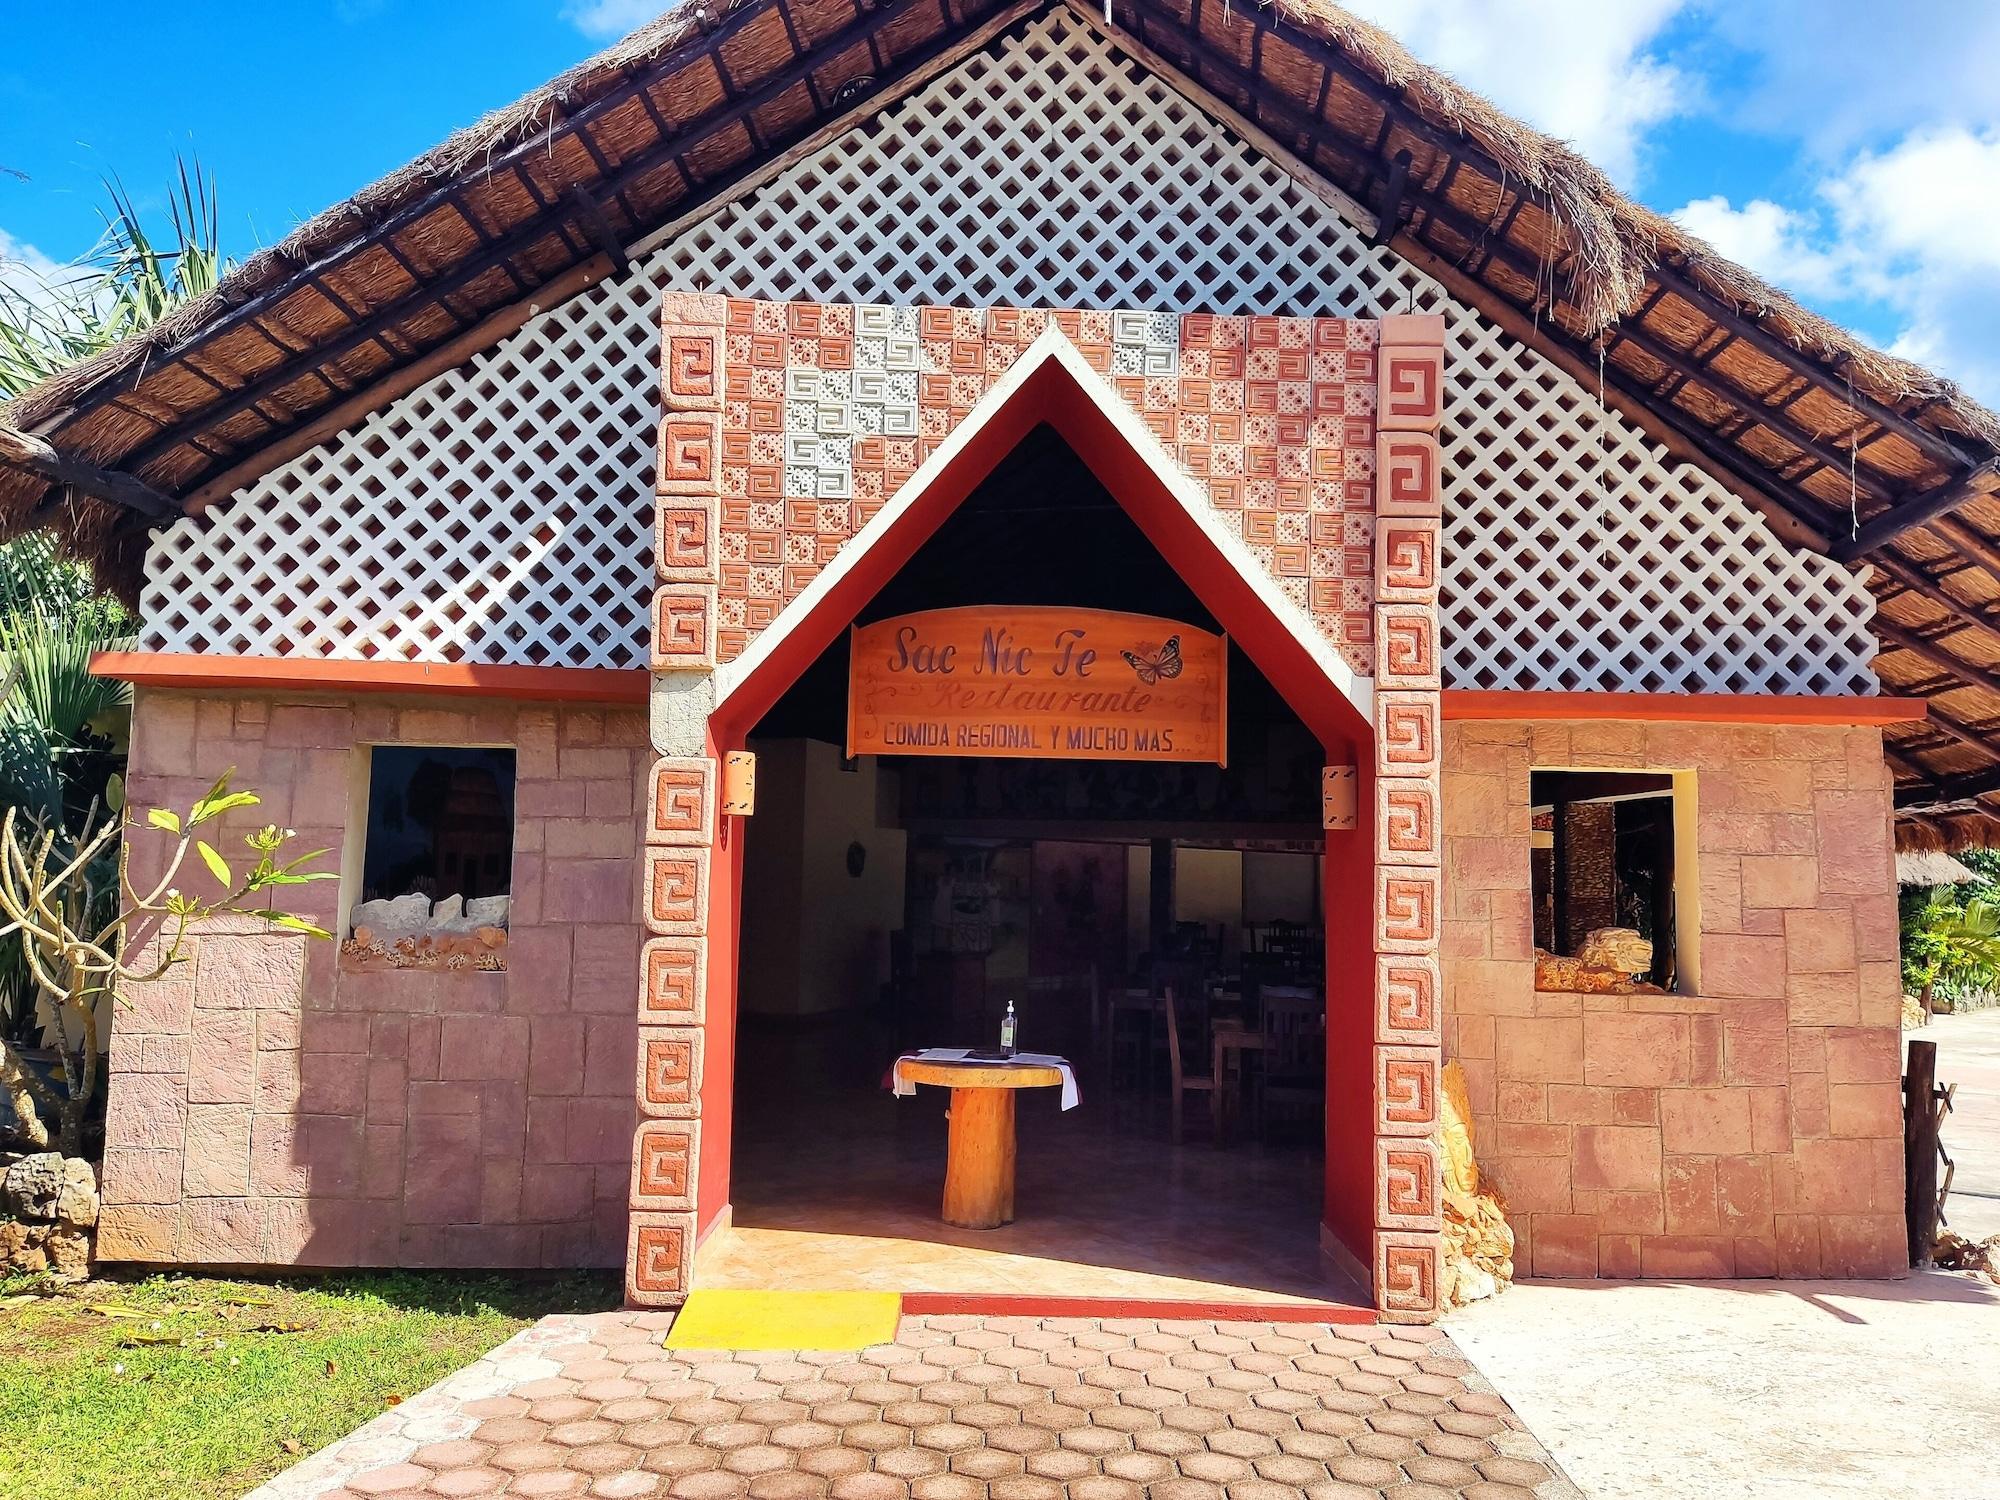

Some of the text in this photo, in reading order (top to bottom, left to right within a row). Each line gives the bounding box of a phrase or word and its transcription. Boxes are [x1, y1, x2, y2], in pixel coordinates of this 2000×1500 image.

[886, 626, 1097, 678] Sac Nic Te
[928, 680, 1151, 713] Restaurante
[884, 721, 950, 747] COMIDA
[956, 723, 1042, 749] REGIONAL
[1050, 725, 1061, 750] Y
[1066, 726, 1129, 751] MUCHO
